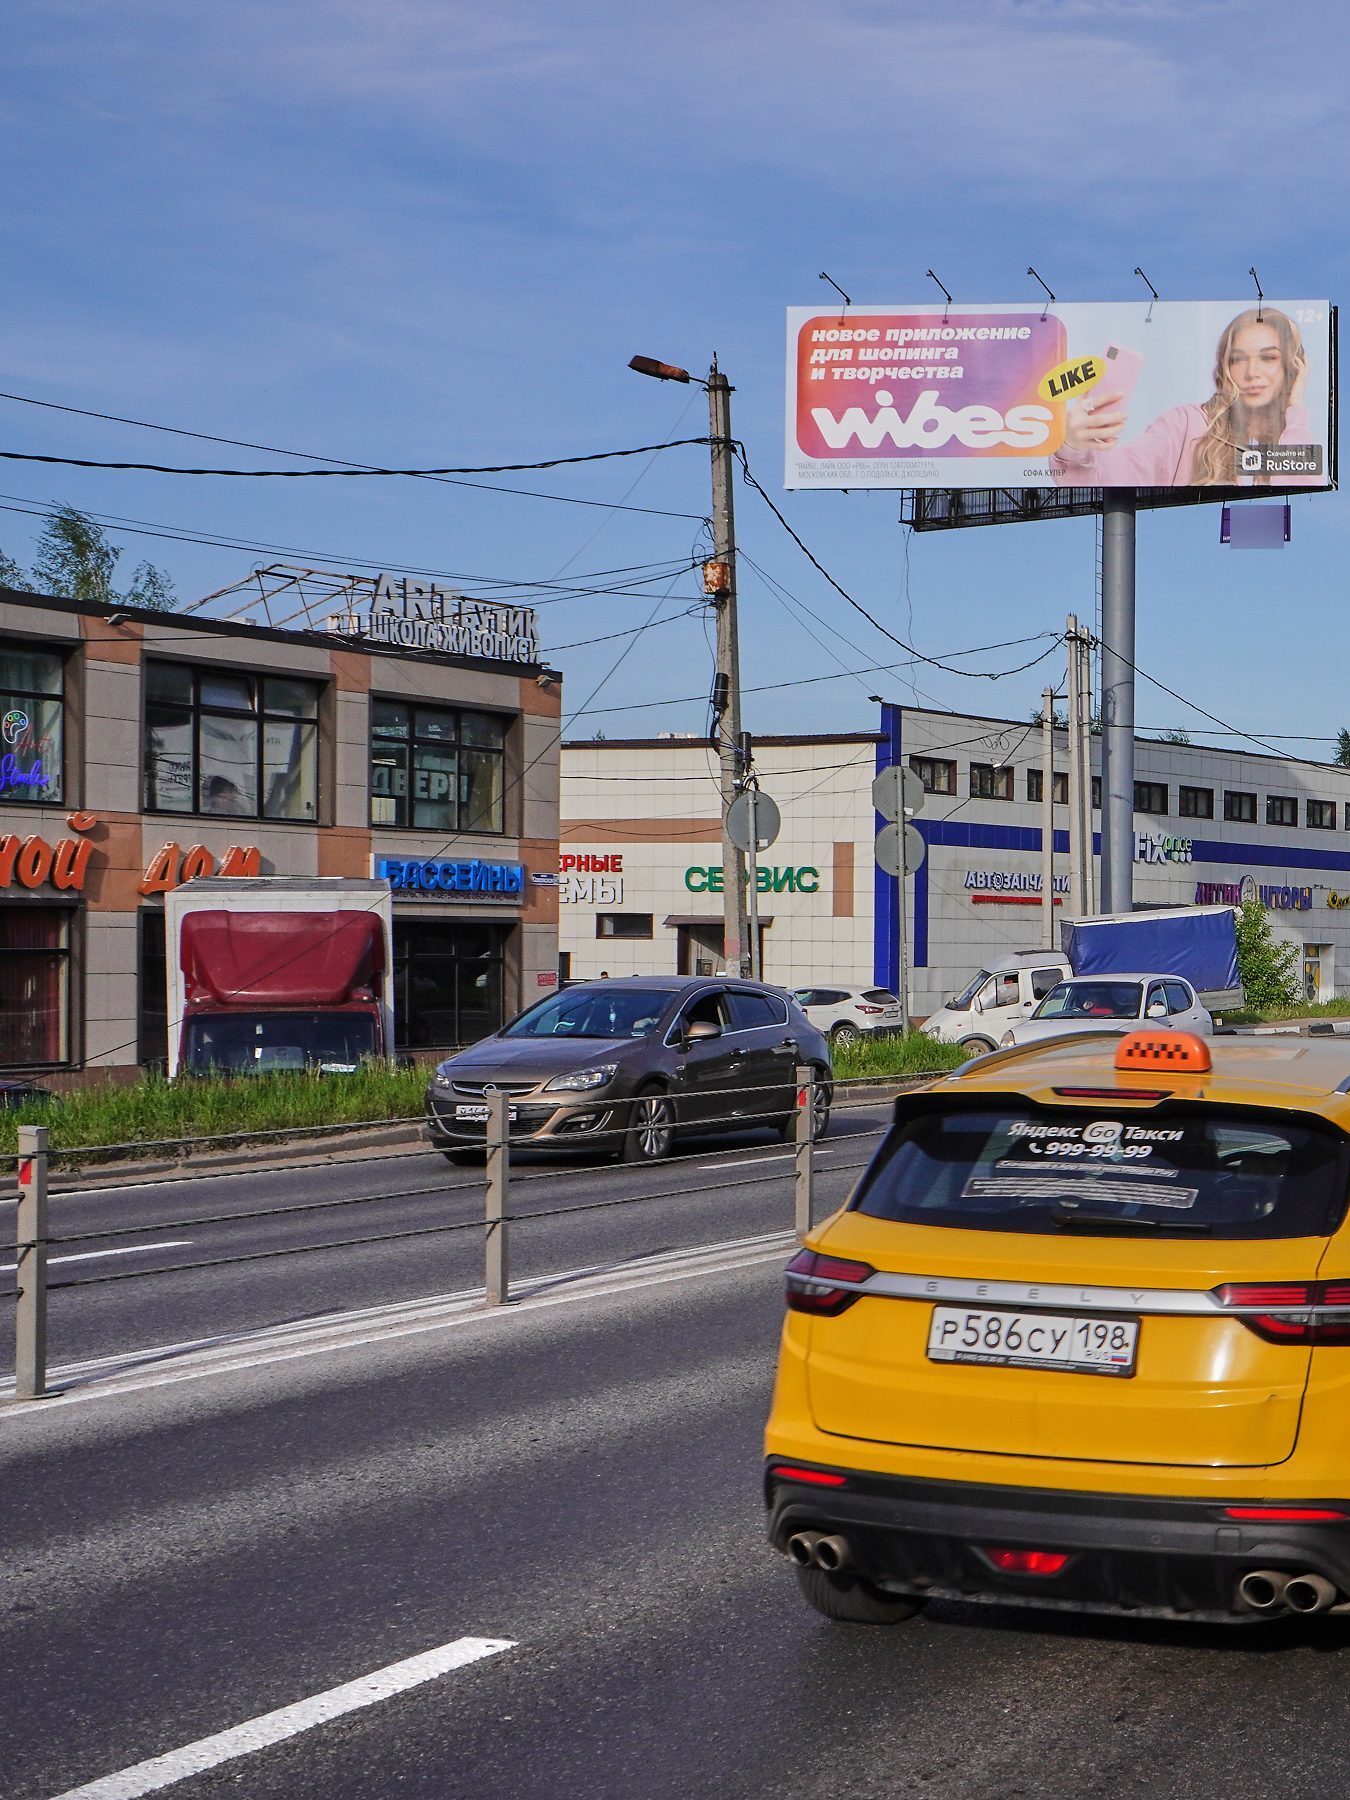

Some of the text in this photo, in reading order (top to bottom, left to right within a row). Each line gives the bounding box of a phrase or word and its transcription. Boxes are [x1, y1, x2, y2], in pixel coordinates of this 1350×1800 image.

[1296, 309, 1325, 323] 12+
[811, 326, 1031, 346] новое приложение
[810, 346, 959, 364] для шопинга
[811, 365, 964, 384] и творчества
[1048, 360, 1096, 397] LIKE
[810, 389, 1053, 449] wibes
[1023, 468, 1066, 477] СОФА КУПЕР
[1266, 460, 1317, 471] RuStore
[459, 599, 540, 640] БУТИК
[370, 613, 437, 650] ШКОЛА
[437, 624, 540, 664] ЖИВОПИСИ
[372, 766, 468, 802] ДВЕРИ
[378, 860, 524, 892] БАССЕЙНЫ
[685, 866, 820, 893] СЕВИС
[1008, 1122, 1083, 1138] Яндекс
[1124, 1126, 1185, 1141] Такси
[1044, 1141, 1153, 1158] 999-99-99
[925, 1281, 1144, 1304] GEELY
[941, 1314, 1127, 1354] Р586СУ 198
